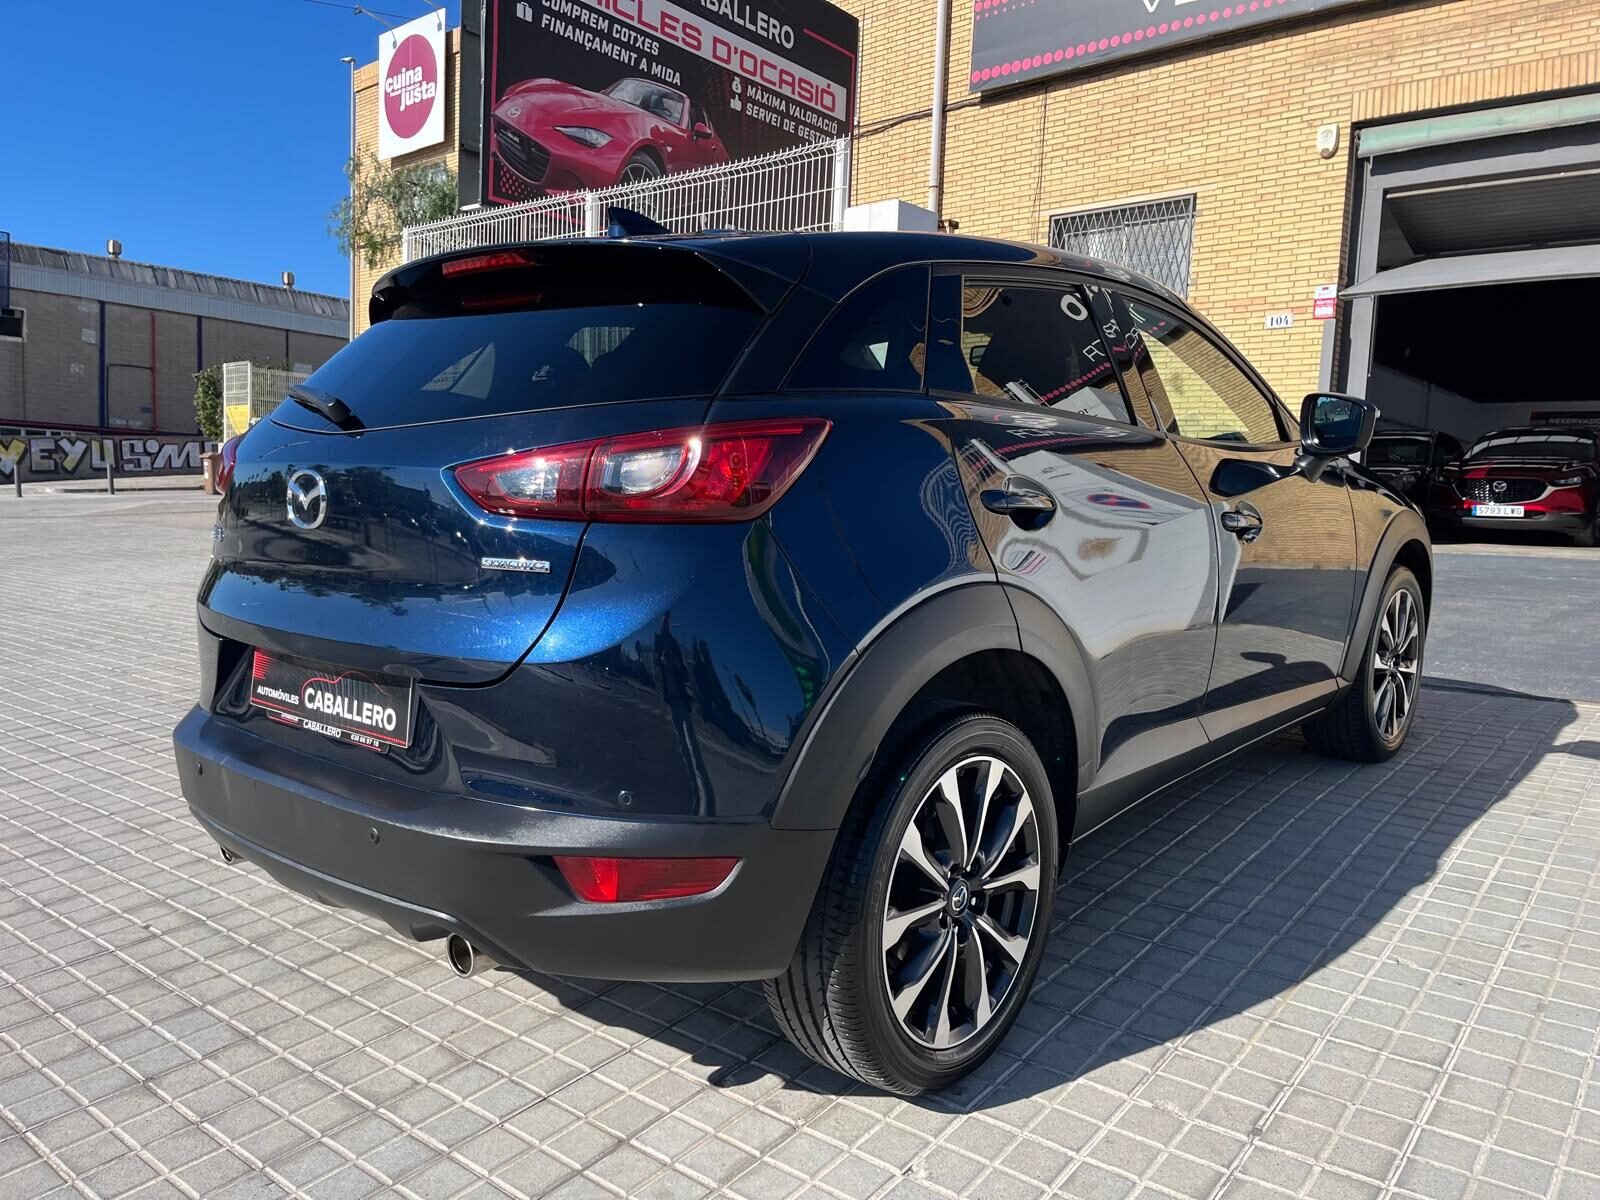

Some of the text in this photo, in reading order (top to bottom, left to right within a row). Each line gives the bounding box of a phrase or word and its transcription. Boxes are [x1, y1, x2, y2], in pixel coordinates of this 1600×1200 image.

[541, 13, 681, 87] FINANÇAMENT A MIDA
[612, 23, 660, 56] COTXES
[385, 66, 422, 93] cuina
[400, 80, 436, 111] justa
[746, 84, 838, 135] MÀXIMA VALORACIÓ
[746, 102, 781, 128] SERVEI
[783, 118, 795, 134] DE
[1270, 315, 1289, 327] 104
[257, 685, 397, 731] AUTOMÓVILES CABALLERO
[303, 719, 342, 738] CABALLERO
